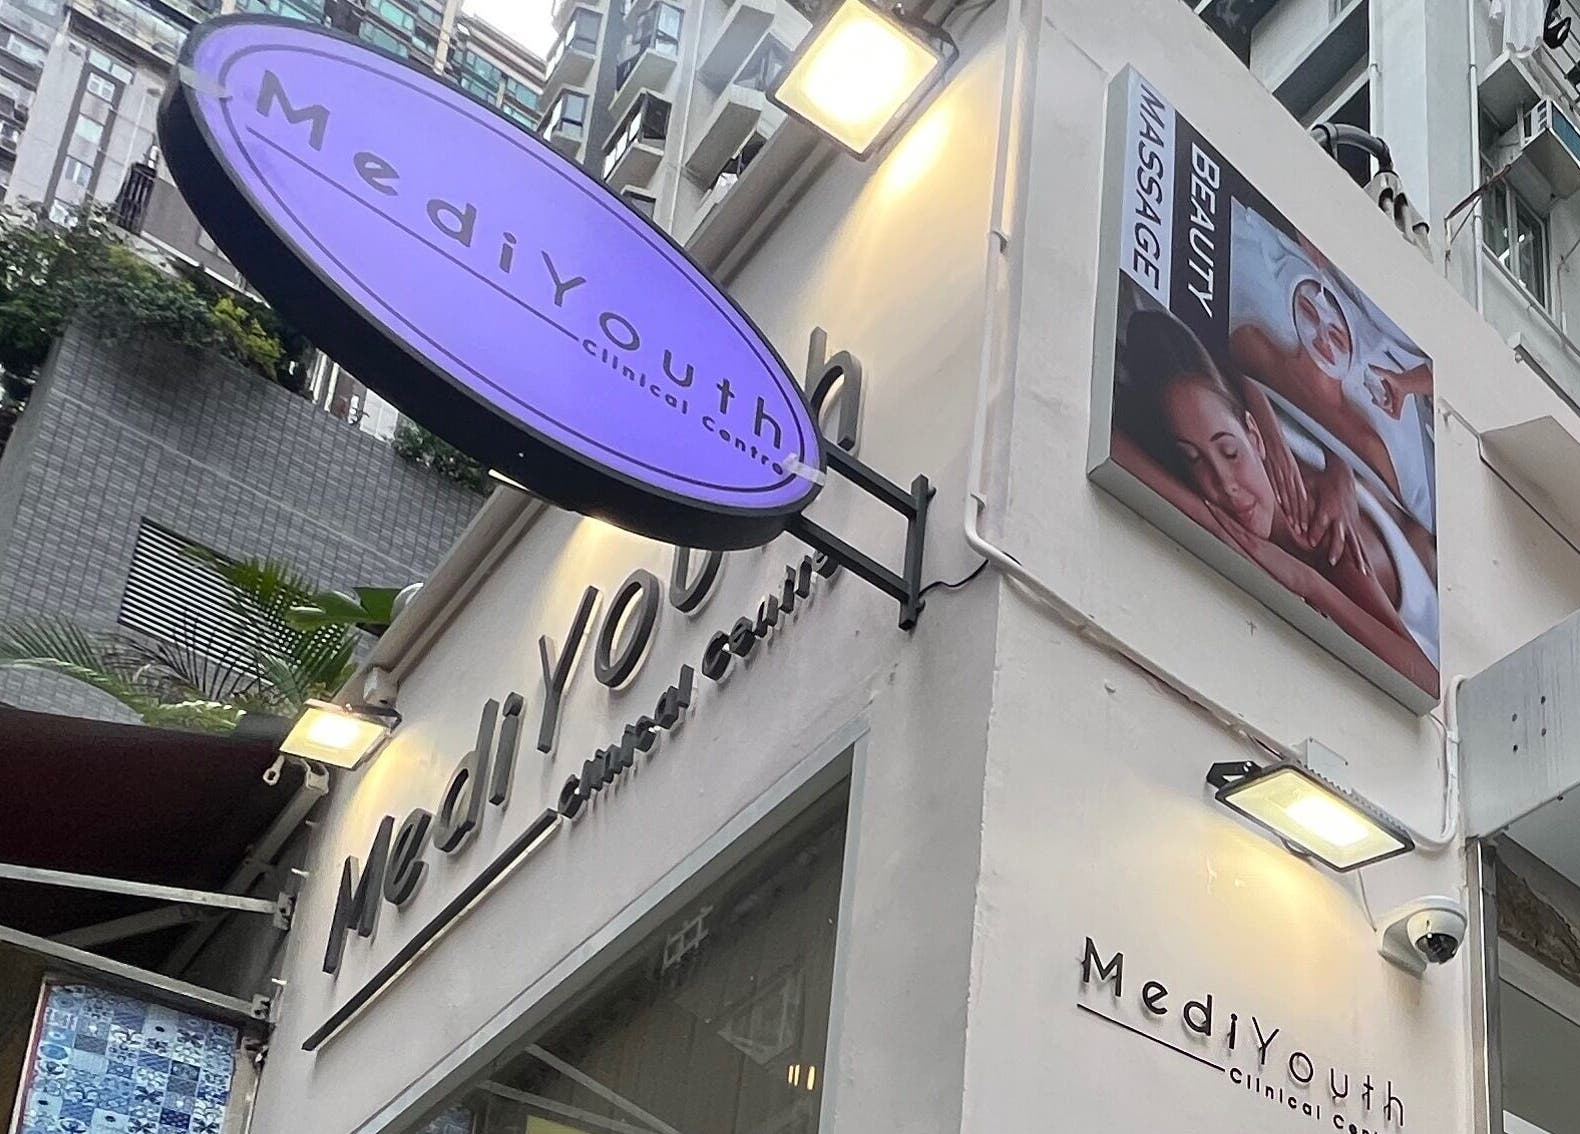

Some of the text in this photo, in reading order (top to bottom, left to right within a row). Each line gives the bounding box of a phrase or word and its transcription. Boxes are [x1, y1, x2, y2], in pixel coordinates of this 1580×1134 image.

[257, 70, 782, 450] MediYouth
[1134, 84, 1166, 290] MASSAGE
[1188, 142, 1220, 318] BEAUTY
[322, 327, 857, 975] MediYouh
[1082, 936, 1404, 1126] MediYouth
[1229, 1067, 1320, 1120] Clinical
